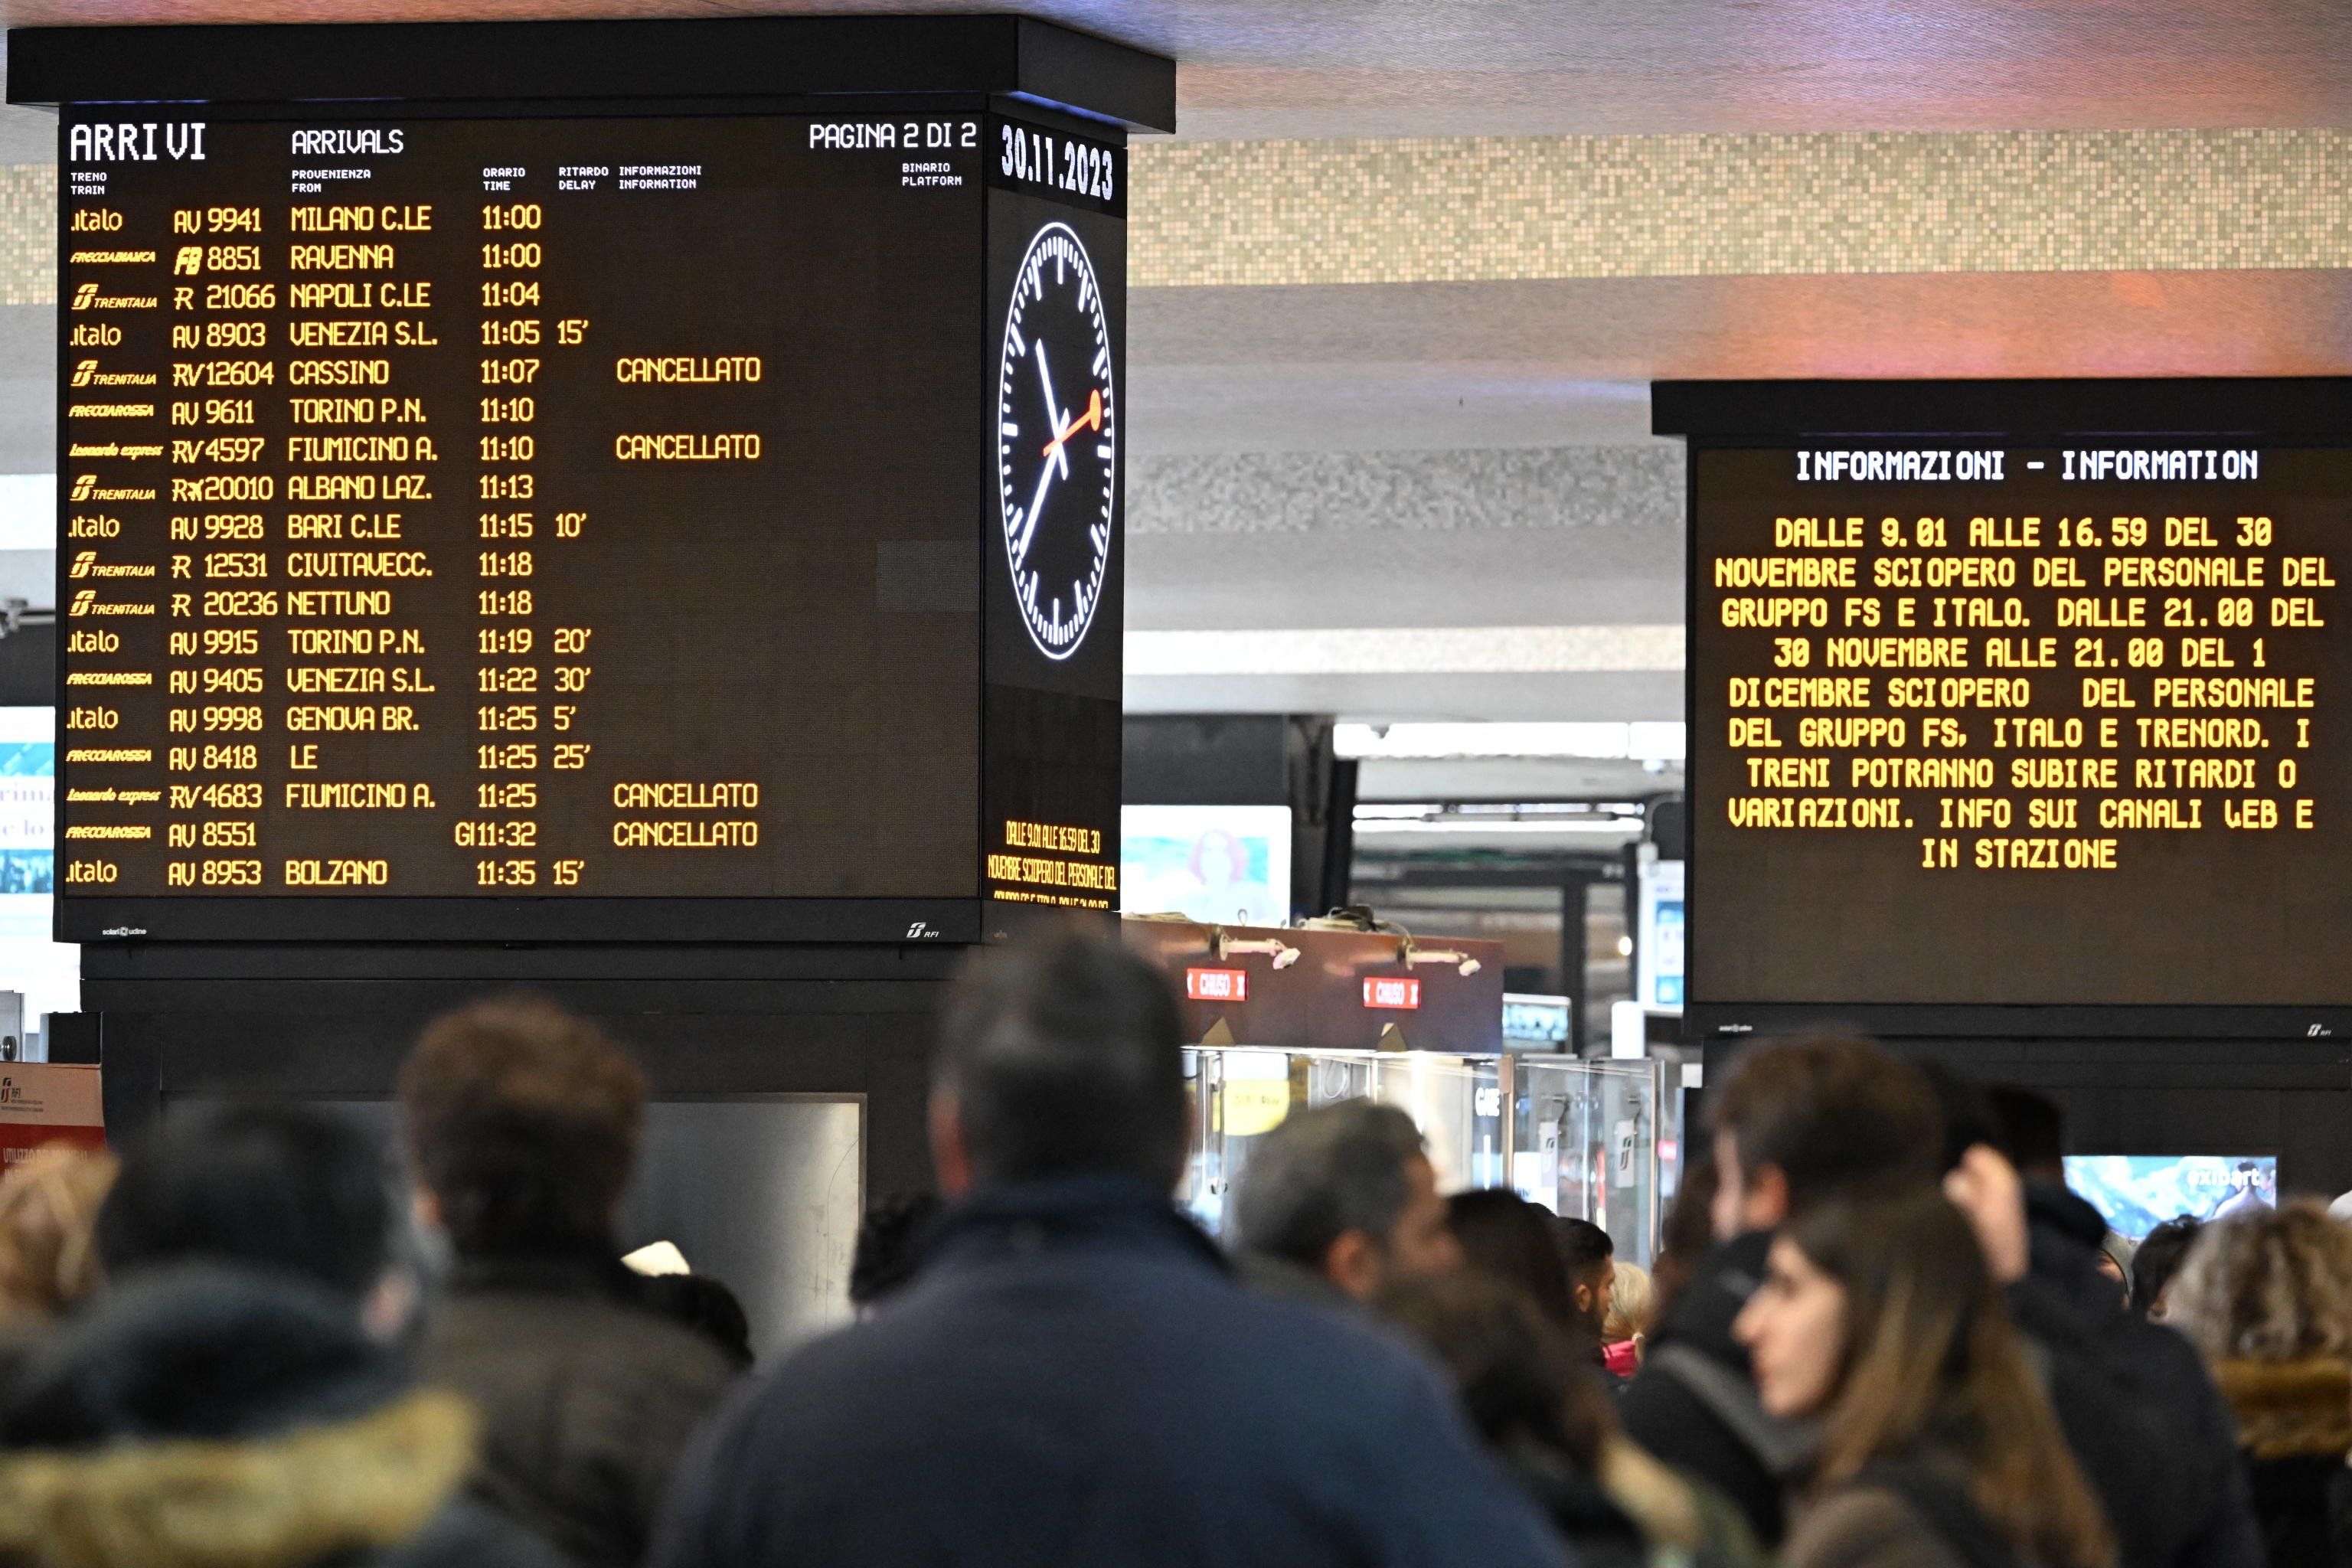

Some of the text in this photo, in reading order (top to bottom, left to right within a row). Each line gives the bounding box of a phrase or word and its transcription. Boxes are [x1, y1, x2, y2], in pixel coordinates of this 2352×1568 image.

[70, 123, 206, 161] ARRIVI
[292, 129, 404, 154] ARRIVALS
[810, 122, 977, 149] PAGINA 2 DI 2
[70, 172, 107, 181] TRENO
[292, 169, 371, 179] PROVENIENZA
[482, 168, 526, 178] ORARIO
[558, 167, 609, 177] RITARDO
[619, 165, 702, 175] INFORMAZIONI
[902, 163, 951, 172] BINARIO
[1001, 125, 1113, 201] 30.11.2023
[70, 186, 105, 195] TRAIN
[292, 183, 322, 192] FROM
[482, 181, 511, 191] TIME
[558, 180, 596, 190] DELAY
[619, 179, 697, 189] INFORMATION
[902, 176, 962, 186] PLATFORM
[175, 204, 541, 234] AV 9941 MILANO C.LE 11:00
[291, 243, 541, 270] RAVENNA 11:00
[207, 282, 540, 309] 21066 NAPOLI C.LE 11:04
[173, 320, 540, 349] AV 8903 VENEZIA S.L. 11:05
[290, 357, 760, 385] CASSINO 11:07 CANCELLATO
[172, 397, 534, 426] AV 9611 TORINO P.N. 11:10
[289, 434, 760, 462] FIUMICINO A. 11:10 CANCELLATO
[1797, 450, 2257, 480] INFORMAZIONI INFORMATION
[288, 474, 533, 500] ALBANO LAZ. 11:13
[172, 513, 533, 541] AV 9928 BARI C.LE 11:15
[1775, 517, 2272, 547] DALLE 9.01 ALLE 16.59 DEL 30
[204, 551, 533, 577] 12531 CIVITAVECC. 11:18
[1715, 557, 2335, 587] NOVEMBRE SCIOPERO DEL PERSONALE DEL
[204, 590, 532, 616] 20236 NETTUNO 11:18
[1722, 597, 2324, 627] GRUPPO FS E ITALO. DALLE 21.00 DEL
[170, 628, 533, 656] AV 9915 TORINO P.N. 11:19
[1775, 638, 2265, 668] 30 NOVEMBRE ALLE 21.00 DEL 1
[170, 667, 537, 694] AV 9405 VENEZIA S.L. 11:22
[1730, 678, 2314, 707] DICEMBRE SCIOPERO DEL PERSONALE
[170, 705, 537, 733] AV 9998 GENOVA BR. 11:25
[1730, 717, 2309, 747] DEL GRUPPO FS, ITALO E TRENORD. I
[170, 743, 537, 771] AV 8418 LE 11:25
[1747, 758, 2296, 789] TRENI POTRANNO SUBIRE RITARDI O
[286, 782, 758, 808] FIUMICINO A. 11:25 CANCELLATO
[1728, 798, 2314, 828] VARIAZIONI. INFO SUI CANALI WEB E
[169, 821, 758, 848] AV 8551 CANCELLATO
[1922, 838, 2117, 868] IN STAZIONE
[169, 860, 536, 887] AV 8953 BOLZANO 11:35
[988, 854, 1103, 889] NOVEMBRE SCIOPERO PERSONALE
